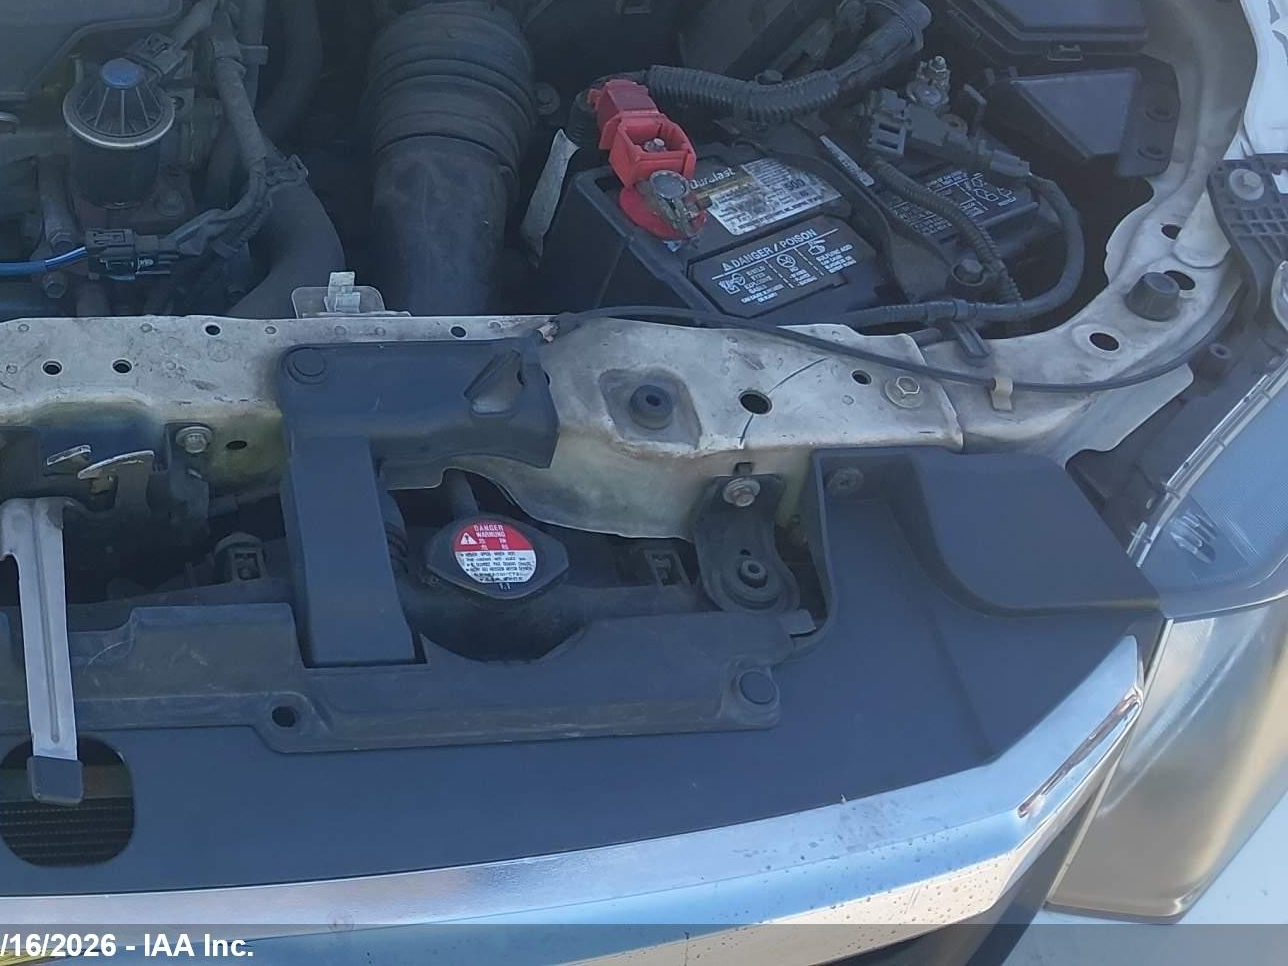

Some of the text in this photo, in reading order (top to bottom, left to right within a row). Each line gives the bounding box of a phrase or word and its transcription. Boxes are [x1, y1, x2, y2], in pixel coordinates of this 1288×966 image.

[689, 167, 736, 189] Duralast
[732, 246, 773, 267] DANGER
[780, 228, 817, 248] POISON
[473, 524, 505, 532] DANGER
